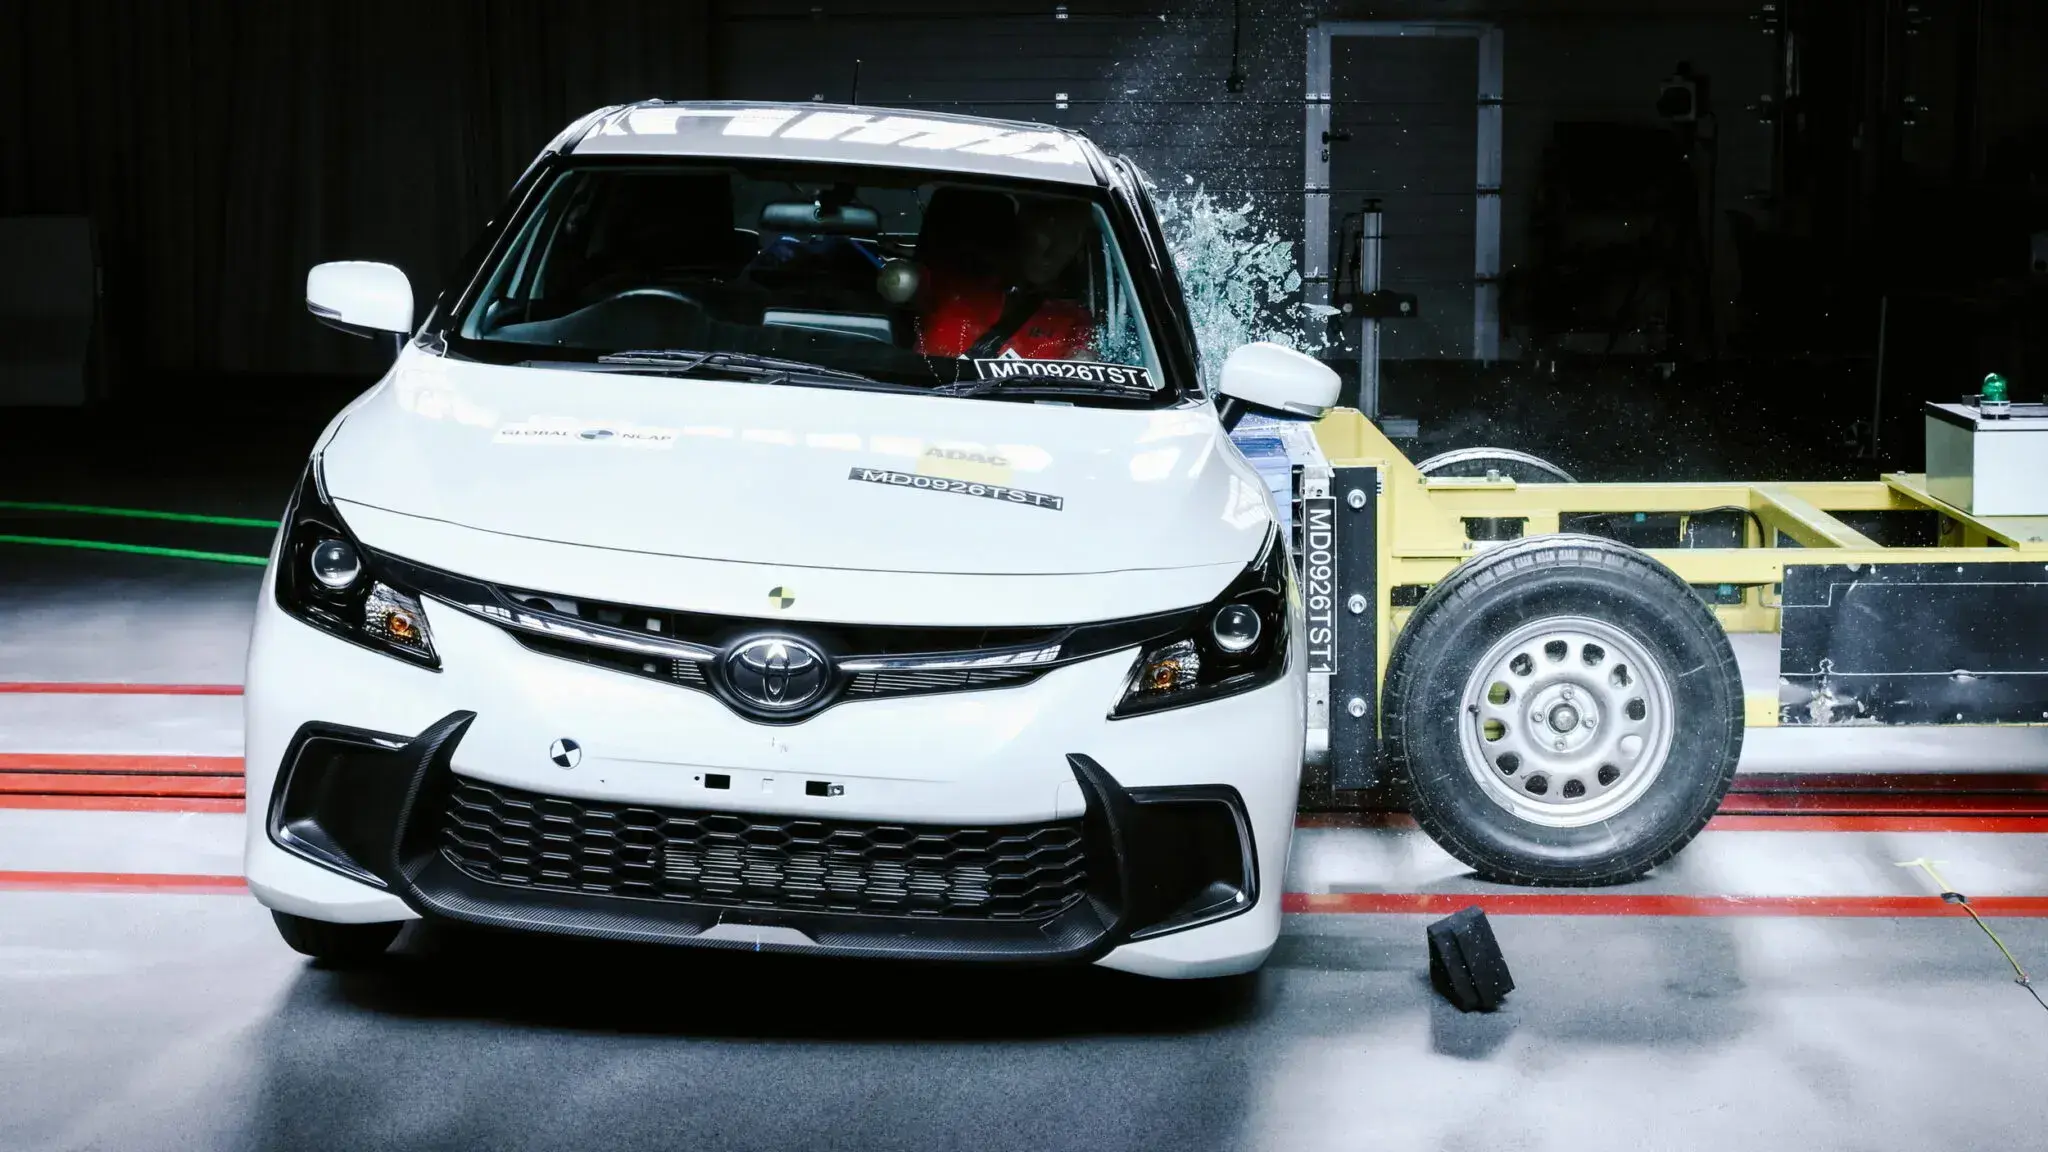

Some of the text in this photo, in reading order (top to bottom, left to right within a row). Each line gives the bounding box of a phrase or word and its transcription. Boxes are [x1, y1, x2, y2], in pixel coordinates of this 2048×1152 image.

[989, 361, 1154, 388] MD0926TST1
[501, 429, 672, 441] GLOBAL NCAP
[925, 446, 1010, 467] ADAC
[861, 469, 1062, 510] MD0926TST1
[1309, 509, 1332, 673] MD0926TST1
